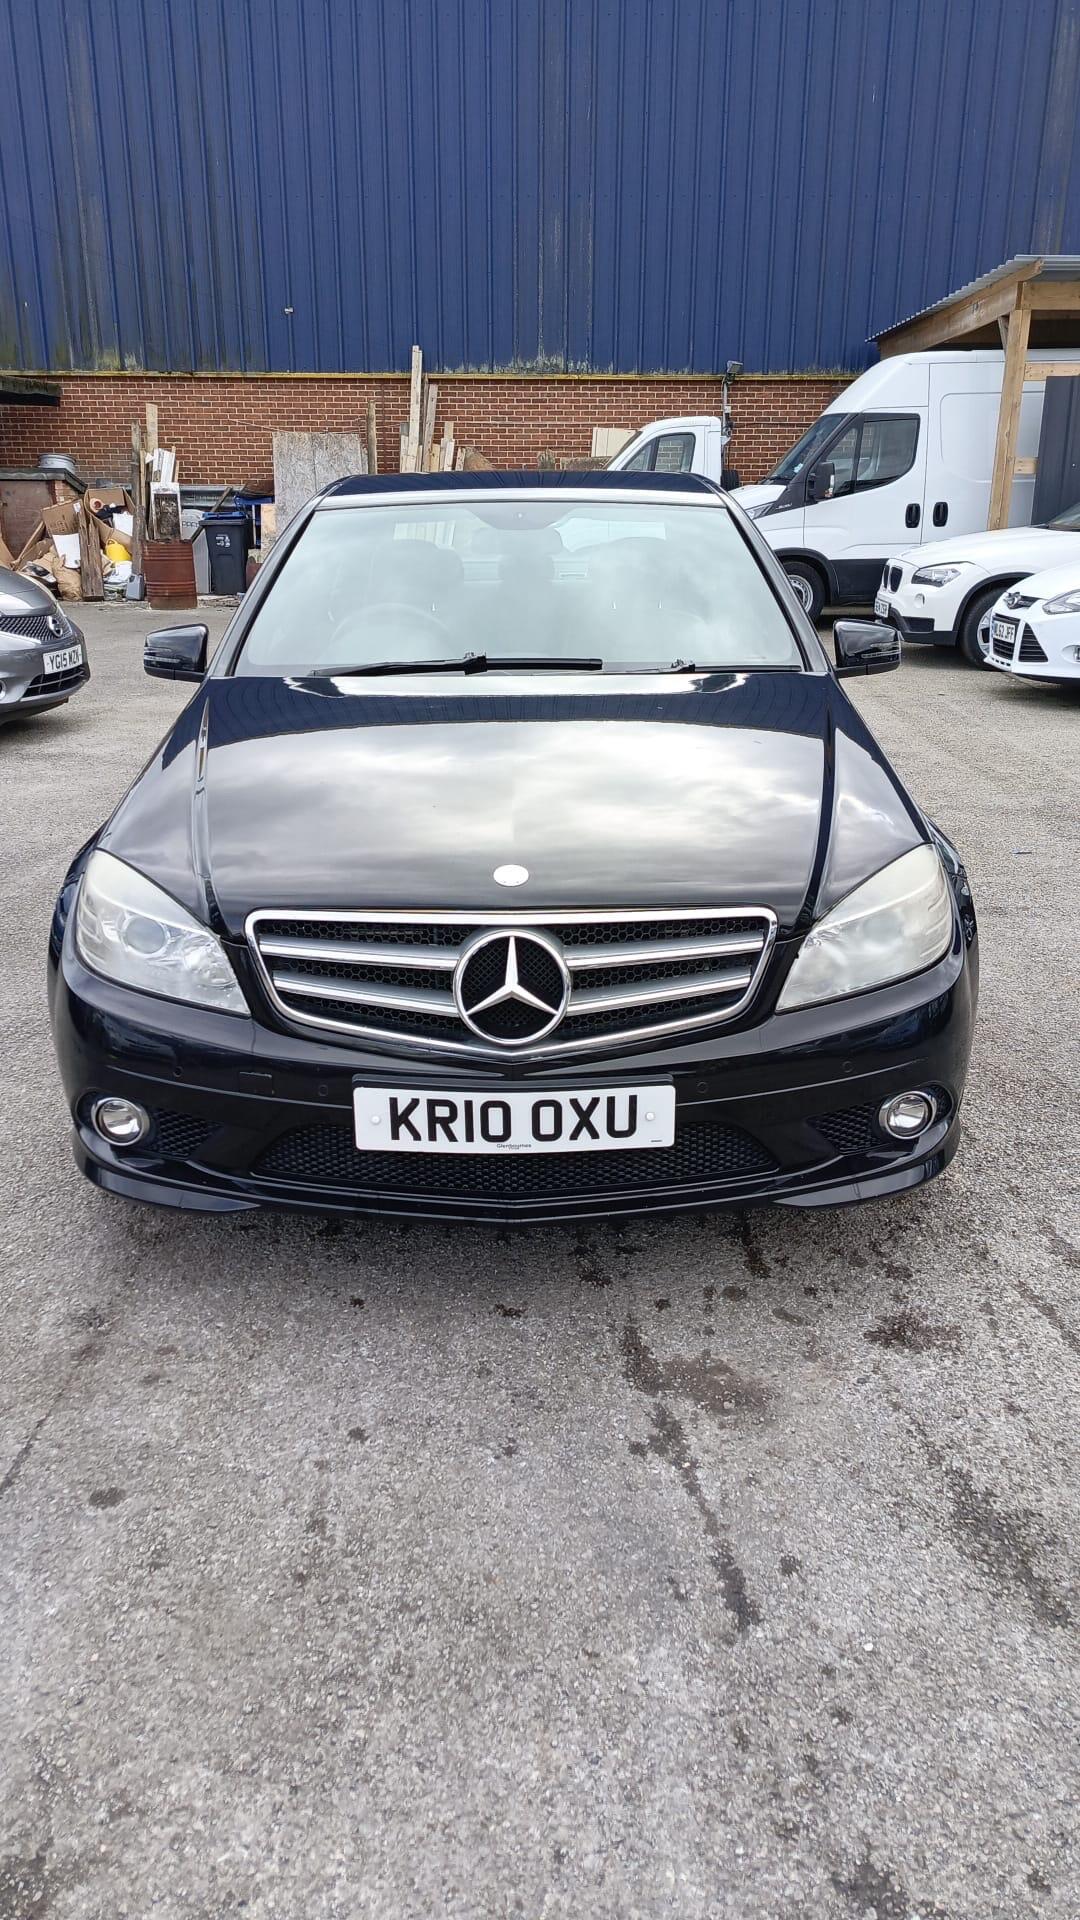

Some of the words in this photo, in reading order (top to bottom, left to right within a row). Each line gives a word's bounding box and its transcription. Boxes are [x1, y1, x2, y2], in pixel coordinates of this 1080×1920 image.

[49, 652, 67, 670] YG15
[388, 1096, 512, 1143] KR10
[531, 1094, 638, 1142] OXU
